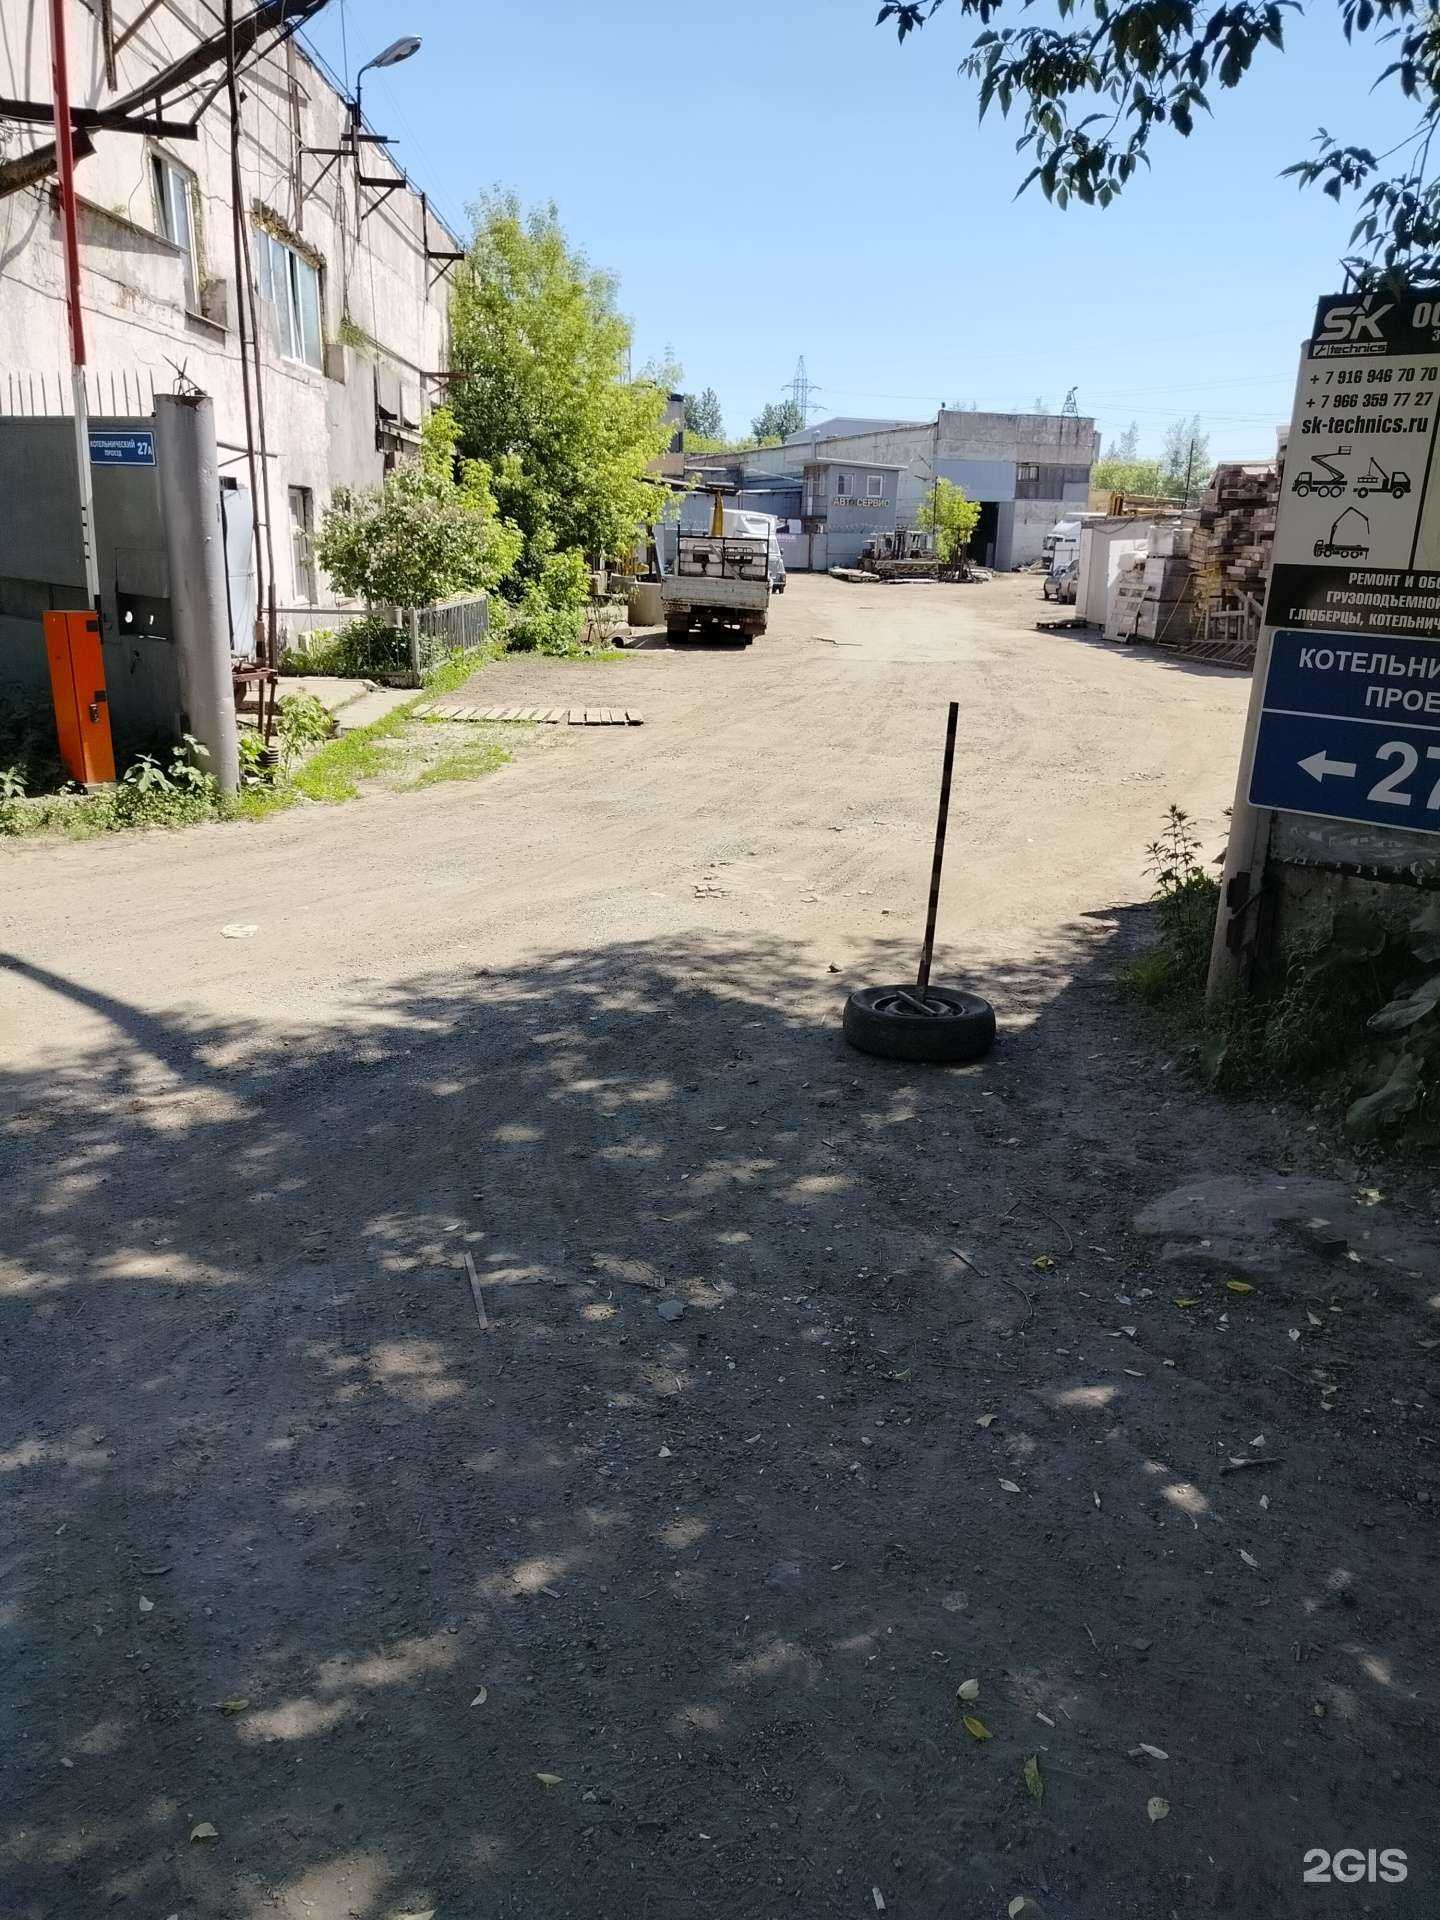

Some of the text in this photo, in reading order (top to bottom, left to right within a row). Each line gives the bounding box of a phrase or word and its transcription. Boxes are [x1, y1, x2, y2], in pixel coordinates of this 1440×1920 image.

[1316, 295, 1394, 341] SK
[1325, 371, 1334, 384] 7
[1337, 369, 1363, 384] 916
[1366, 368, 1393, 383] 946
[1398, 367, 1416, 382] 70
[1420, 366, 1438, 381] 70
[1321, 394, 1330, 408] 7
[1333, 393, 1359, 408] 966
[1362, 393, 1388, 407] 359
[1393, 392, 1411, 406] 77
[1414, 391, 1434, 406] 27
[1301, 414, 1429, 434] sk-technics.ru
[1348, 572, 1400, 587] РЕМОНТ
[1404, 575, 1414, 588] И
[1365, 686, 1440, 713] ПРОЕ
